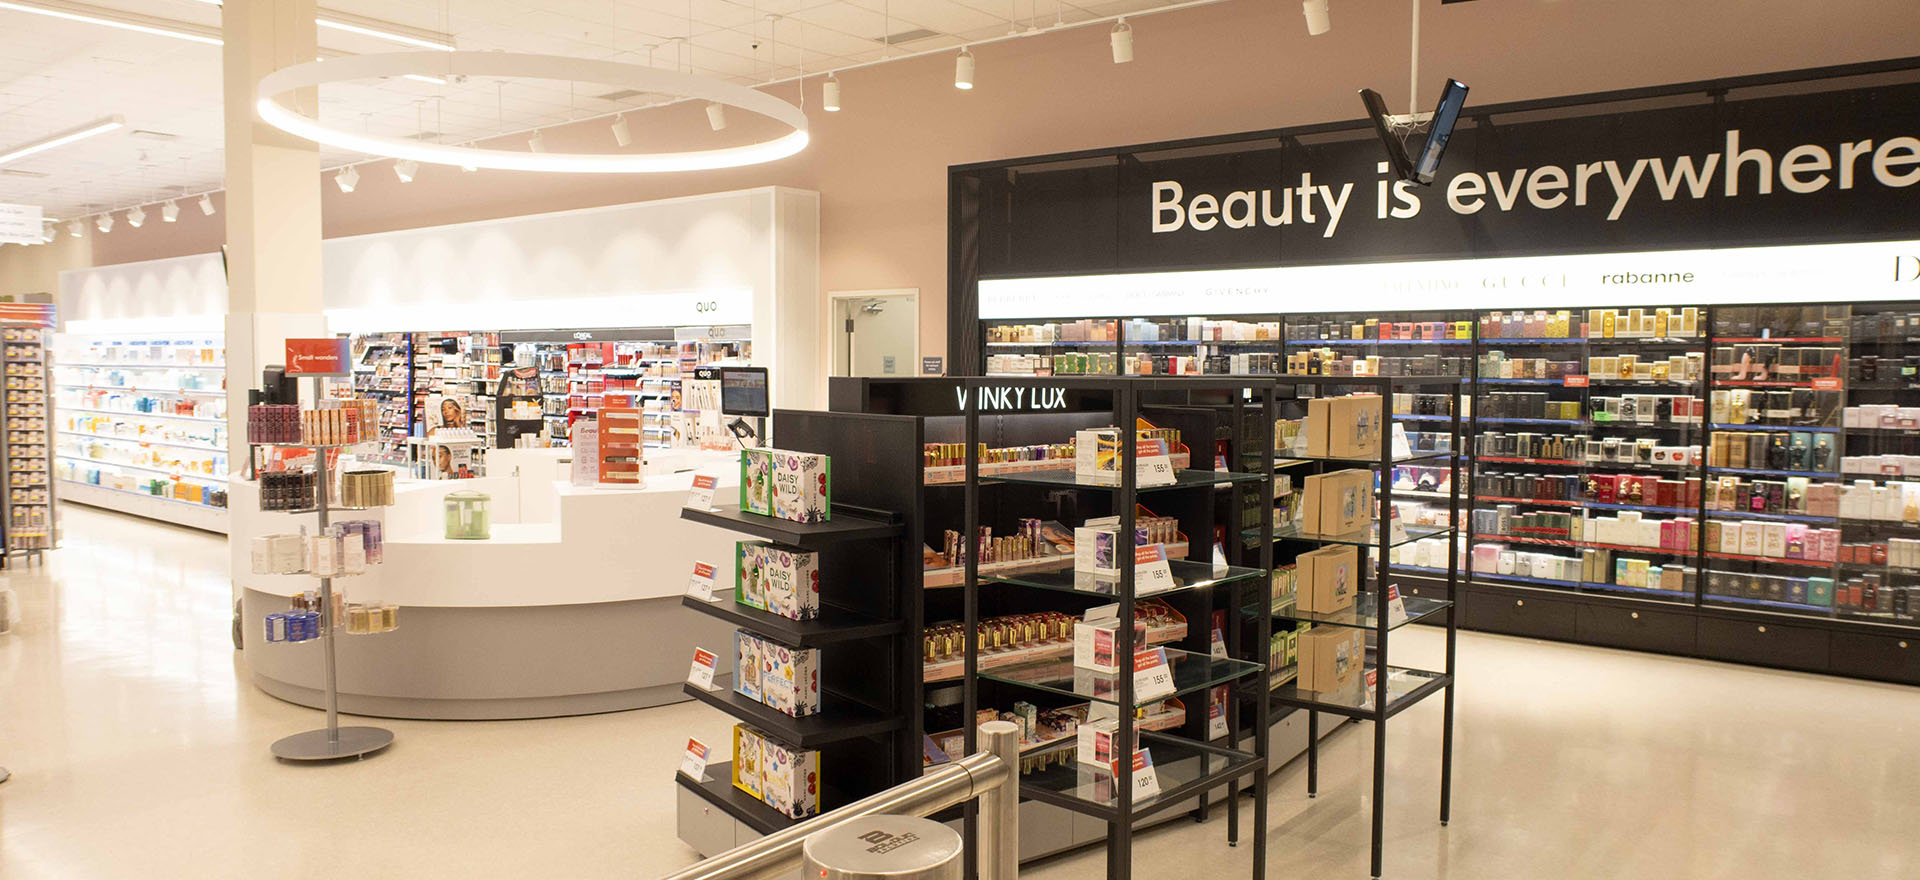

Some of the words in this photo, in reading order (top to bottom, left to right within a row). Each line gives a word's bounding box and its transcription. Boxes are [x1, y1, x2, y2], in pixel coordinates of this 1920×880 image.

[1152, 172, 1354, 238] Beauty
[1377, 161, 1421, 220] is
[1447, 129, 1920, 221] everywhere
[1602, 271, 1695, 285] rabanne
[696, 301, 717, 313] QUO
[708, 328, 726, 338] QUO
[1030, 387, 1067, 409] LUX
[778, 472, 798, 484] DAISY
[779, 483, 797, 494] WILD
[770, 568, 791, 581] DAISY
[771, 578, 790, 591] WILD
[1153, 674, 1164, 685] 155
[1137, 777, 1149, 788] 120
